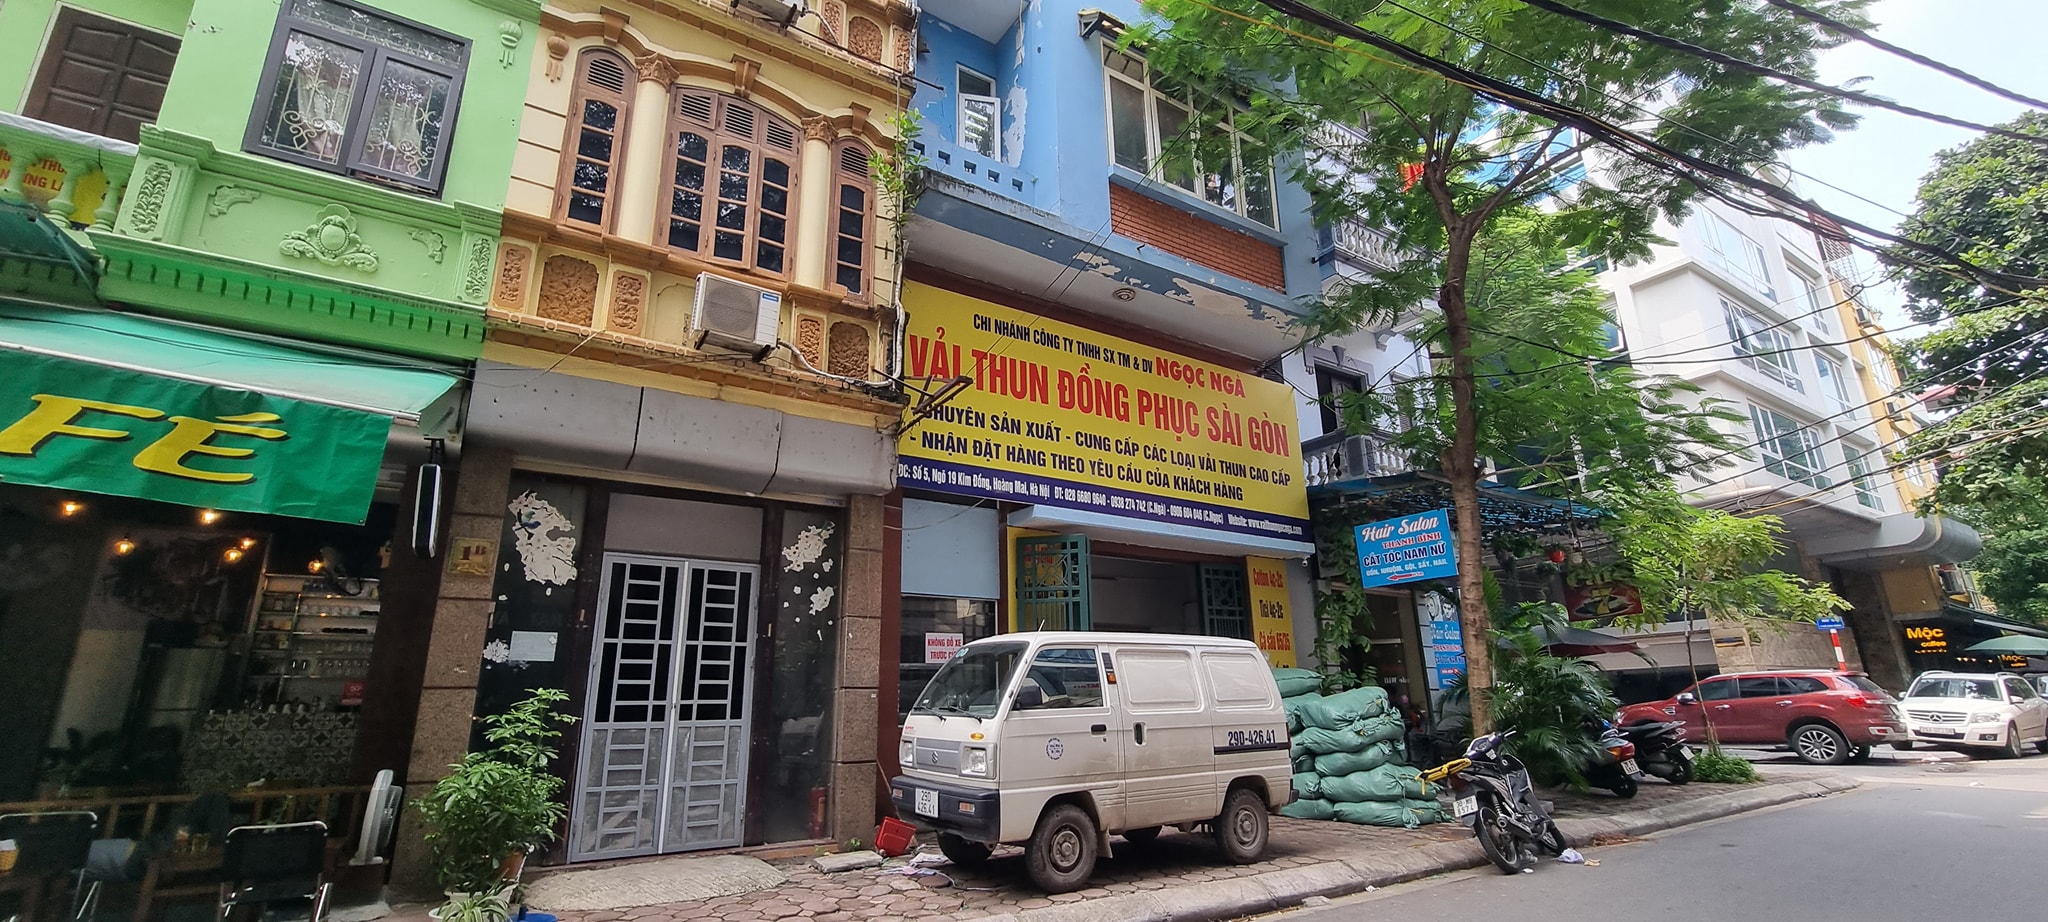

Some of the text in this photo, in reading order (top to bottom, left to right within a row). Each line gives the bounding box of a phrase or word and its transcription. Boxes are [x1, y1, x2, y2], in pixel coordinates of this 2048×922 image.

[973, 313, 1246, 398] CHI NHÁNH CÔNG TY TNHH SX TM & DV NGỌC NGÀ
[908, 327, 1290, 457] VẢI THUN ĐỒNG PHỤC SÀI GÒN
[921, 431, 968, 457] NHẬN
[972, 437, 1002, 462] ĐẶT
[1006, 444, 1047, 468] HÀNG
[1050, 452, 1085, 474] THEO
[1088, 457, 1114, 478] YÊU
[1117, 461, 1142, 483] CẦU
[1145, 466, 1170, 489] CỦA
[1173, 474, 1212, 496] KHÁCH
[1213, 480, 1244, 501] HÀNG
[990, 411, 1022, 435] SẢN
[1025, 419, 1062, 443] XUẤT
[1075, 430, 1111, 453] CUNG
[1114, 436, 1140, 458] CẤP
[1143, 443, 1168, 463] CÁC
[1170, 449, 1196, 469] LOẠI
[1198, 452, 1217, 473] VẢI
[1218, 459, 1247, 479] THUN
[1249, 466, 1270, 482] CAO
[1271, 467, 1291, 487] CẤP
[912, 464, 923, 480] Số
[923, 467, 931, 482] 5,
[948, 470, 956, 485] 19
[958, 472, 972, 487] Kim
[993, 477, 1013, 494] Hoàng
[1030, 482, 1038, 497] Hà
[1039, 483, 1050, 500] Nội
[1064, 488, 1076, 502] 028
[1361, 515, 1440, 543] Hair Salon
[1382, 536, 1416, 550] THANH
[1403, 546, 1428, 561] NAM
[1905, 626, 1945, 641] Mộc
